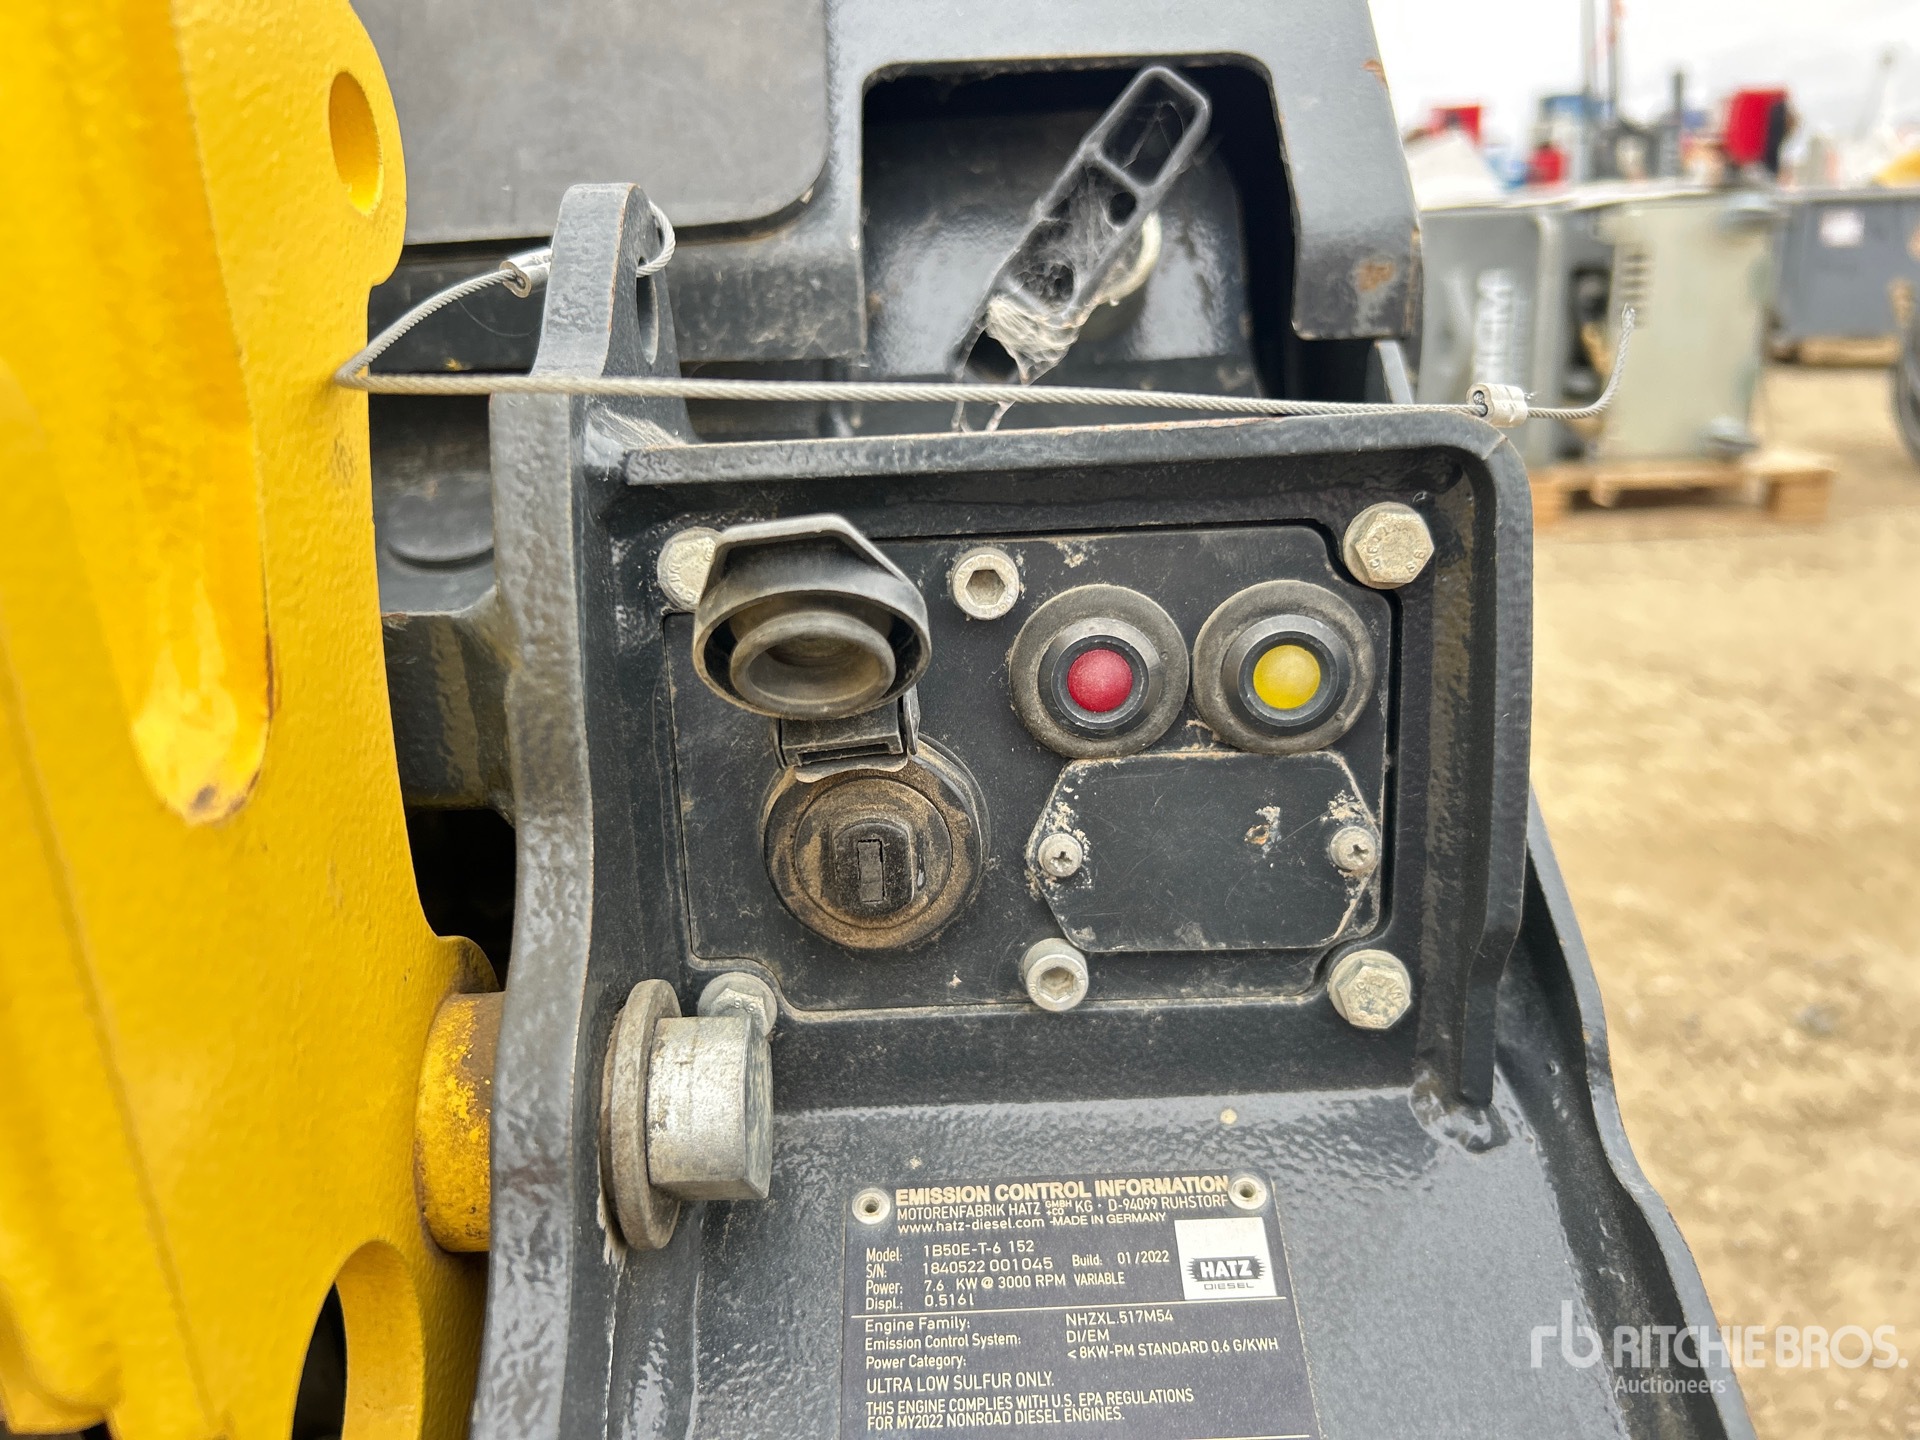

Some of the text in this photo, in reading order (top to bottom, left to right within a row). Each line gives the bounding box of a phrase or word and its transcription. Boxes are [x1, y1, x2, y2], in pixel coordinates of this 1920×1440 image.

[896, 1174, 1229, 1206] EMISSION CONTROL INFORMATION
[897, 1194, 1228, 1221] MOTORENFABRIK HATZ GMBH KG D-94099 RUHSTORF
[898, 1216, 1045, 1234] www.hatz-diesel.com
[1091, 1214, 1104, 1225] IN
[1106, 1212, 1166, 1225] GERMANY
[866, 1240, 1035, 1262] Model: 1B50E-T-6 152
[866, 1263, 888, 1278] S/N:
[923, 1261, 985, 1276] 1840522
[989, 1256, 1054, 1272] 001045
[1072, 1254, 1103, 1267] Build:
[1200, 1259, 1253, 1279] HATZ
[866, 1271, 1126, 1296] Power: 7.6 KW @ 3000 RPM VARIABLE
[1203, 1282, 1254, 1290] DIESEL
[865, 1316, 970, 1335] Engine Family:
[1066, 1309, 1174, 1326] NHZXL.517M54
[865, 1332, 1021, 1351] Emission Control System:
[1066, 1329, 1110, 1343] DI/EM
[1079, 1343, 1135, 1359] 8KW-PM
[1138, 1339, 1208, 1356] STANDARD
[1211, 1340, 1230, 1353] 0.6
[1233, 1337, 1279, 1352] G/KWH
[866, 1354, 967, 1371] Power Category:
[866, 1370, 1055, 1394] ULTRA LOW SULFUR ONLY.
[866, 1388, 1195, 1415] THIS ENGINE COMPLIES WITH U.S. EPA REGULATIONS
[867, 1406, 1125, 1431] FOR MY2022 NONROAD DIESEL ENGINES.
